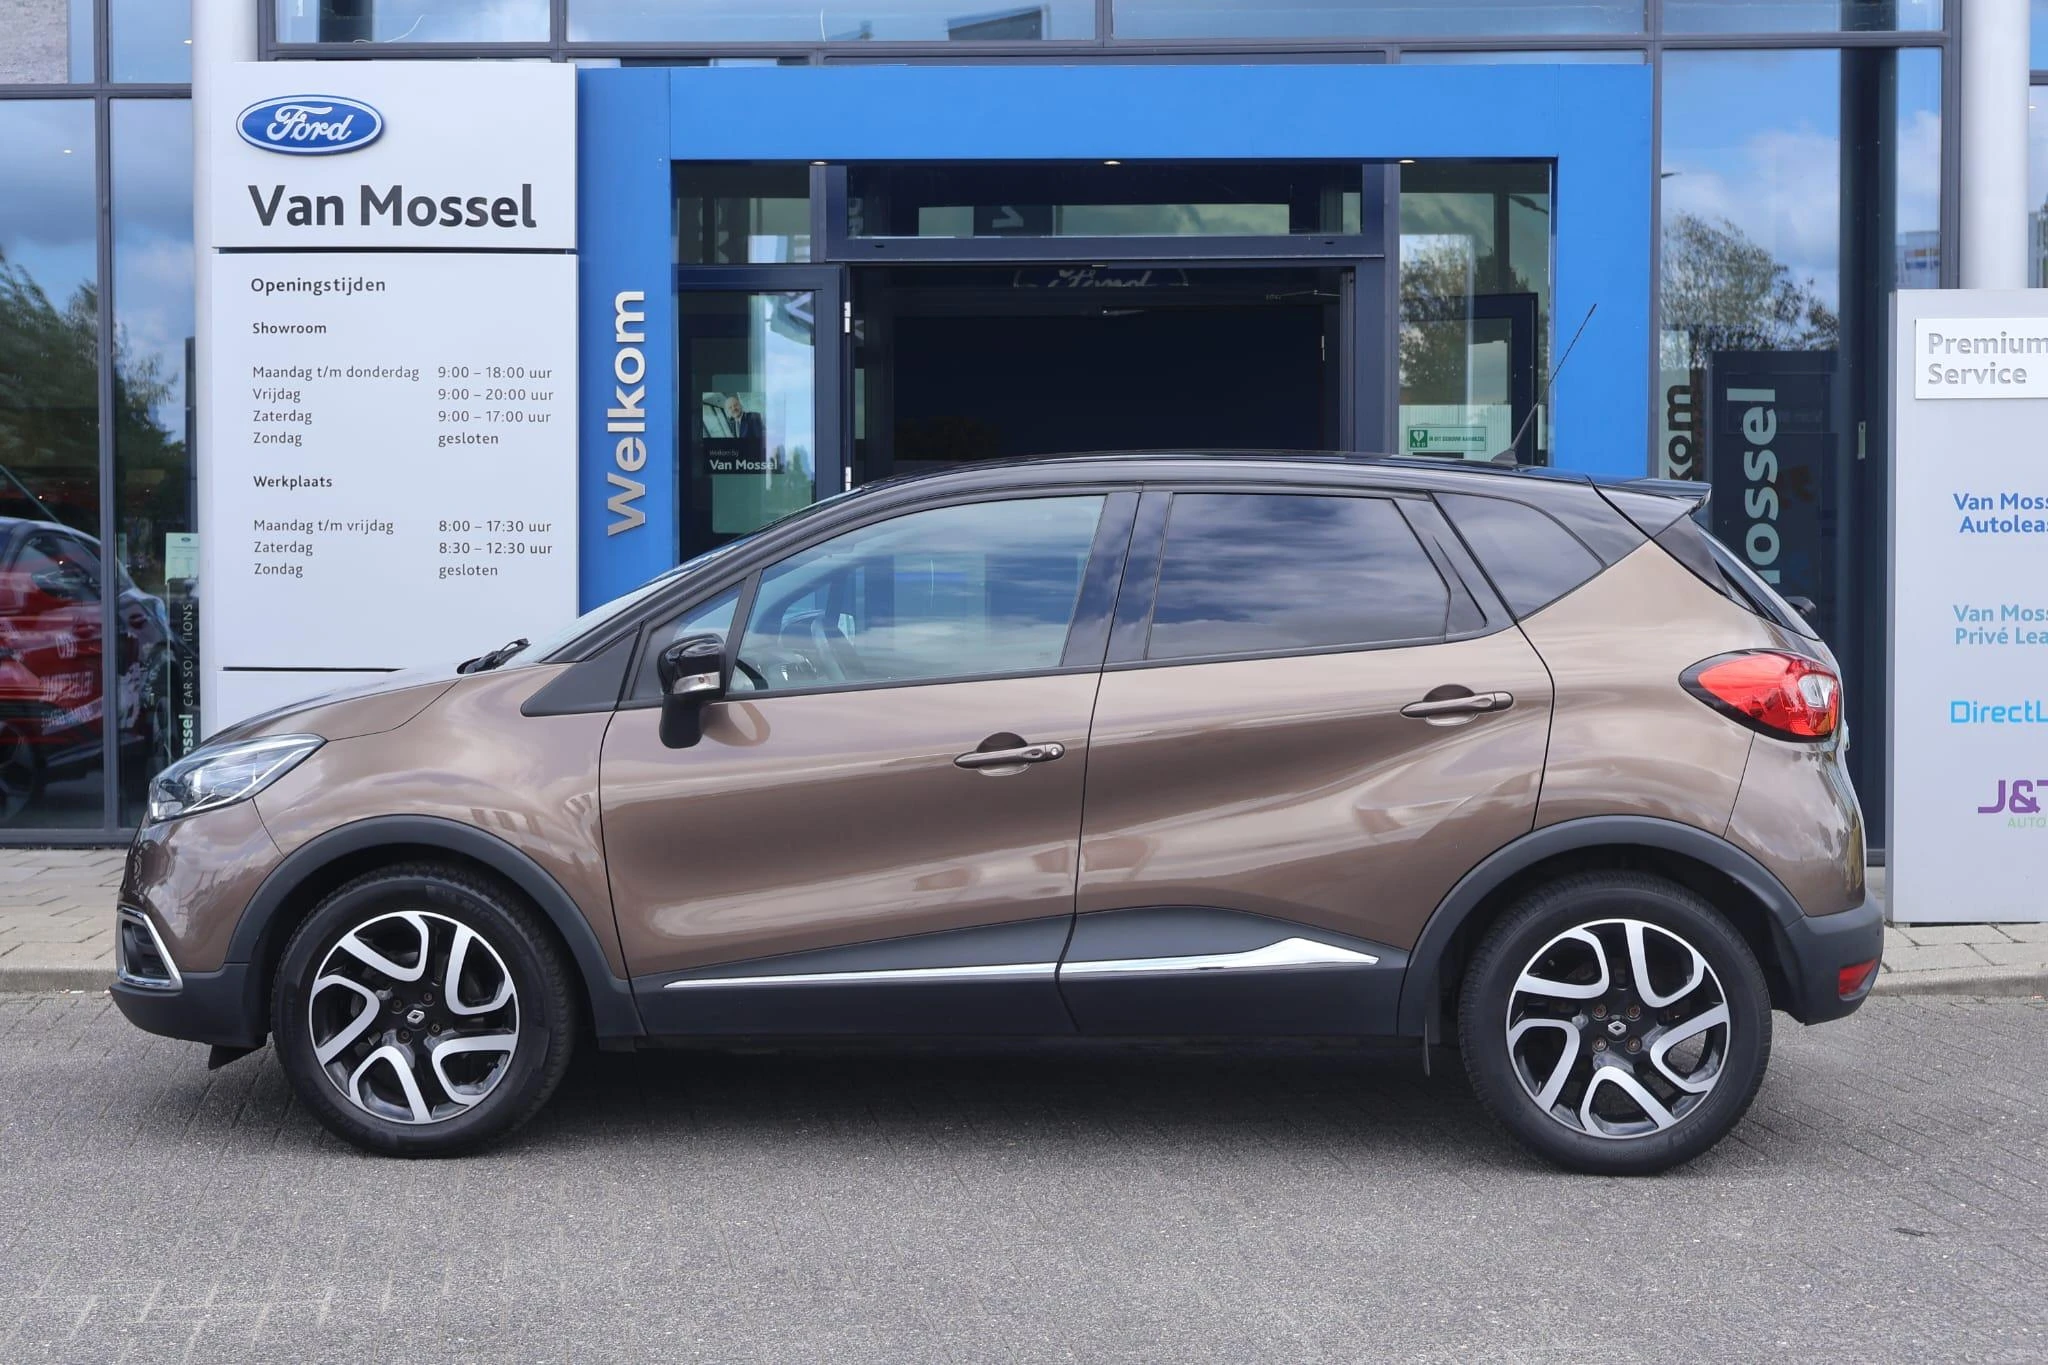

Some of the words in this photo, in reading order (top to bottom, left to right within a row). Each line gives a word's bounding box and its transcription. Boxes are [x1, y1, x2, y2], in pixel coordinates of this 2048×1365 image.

[266, 104, 354, 141] Ford
[248, 185, 343, 226] Van
[361, 184, 536, 228] Mossel
[251, 277, 385, 296] Openingstijden
[253, 322, 326, 334] Showroom
[1929, 331, 2048, 354] Premium
[254, 366, 312, 381] Maandag
[318, 366, 341, 377] t/m
[347, 366, 419, 381] donderdag
[438, 367, 469, 378] 9:00
[486, 367, 524, 378] 18:00
[530, 370, 552, 378] uur
[1928, 362, 2027, 384] Service
[253, 388, 300, 403] Vrijdag
[439, 389, 469, 400] 9:00
[486, 389, 525, 400] 20:00
[532, 392, 553, 400] uur
[254, 410, 312, 425] Zaterdag
[439, 411, 469, 422] 9:00
[486, 411, 523, 422] 17:00
[529, 414, 551, 422] uur
[607, 291, 647, 537] Welkom
[254, 432, 302, 447] Zondag
[439, 432, 498, 447] gesloten
[709, 459, 732, 470] Van
[735, 459, 778, 470] Mossel
[254, 475, 332, 490] Werkplaats
[1727, 388, 1781, 585] ossel
[1953, 493, 1993, 510] Van
[2001, 493, 2048, 510] Mos
[254, 520, 313, 534] Maandag
[318, 520, 342, 531] t/m
[347, 520, 393, 535] vrijdag
[439, 520, 470, 532] 8:00
[487, 521, 523, 532] 17:30
[529, 524, 551, 532] uur
[1960, 515, 2048, 533] Autolea
[255, 541, 312, 556] Zaterdag
[440, 543, 470, 553] 8:30
[487, 543, 524, 554] 12:30
[530, 546, 552, 554] uur
[255, 563, 303, 578] Zondag
[439, 564, 497, 579] gesloten
[1953, 605, 1993, 622] Van
[2001, 604, 2048, 621] Mos
[182, 603, 194, 678] SOTIONS
[1956, 627, 2008, 644] Privé
[183, 682, 194, 708] CAR
